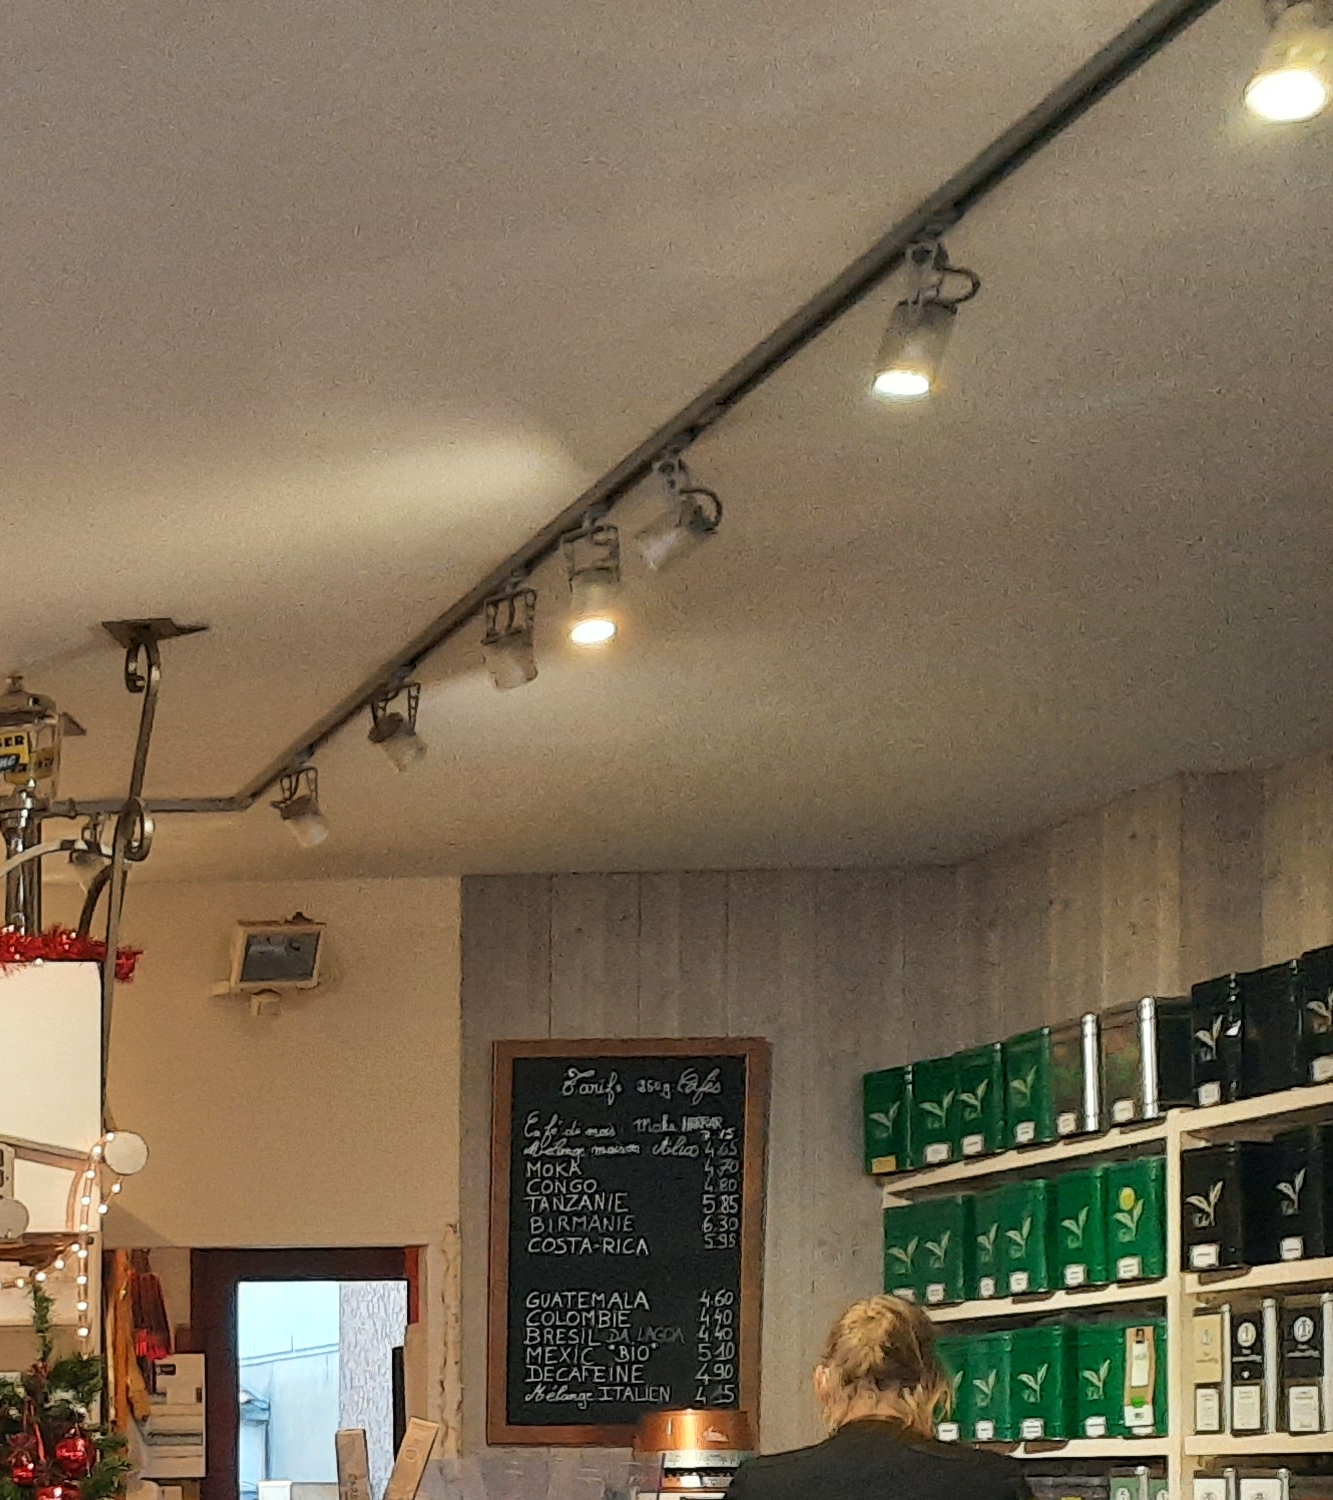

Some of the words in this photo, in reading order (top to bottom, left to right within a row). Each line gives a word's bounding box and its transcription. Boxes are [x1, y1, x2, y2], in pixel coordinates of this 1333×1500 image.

[525, 1160, 582, 1178] MOKA
[526, 1179, 597, 1194] CONGO
[524, 1193, 628, 1213] TANZANIE
[530, 1215, 634, 1234] BIRMANIE
[527, 1238, 650, 1255] COSTA-RICA
[525, 1291, 650, 1311] GUATEMALA
[525, 1310, 632, 1328] COLOMBIE
[523, 1328, 602, 1345] BRESIL
[524, 1365, 645, 1384] DECAFEINE
